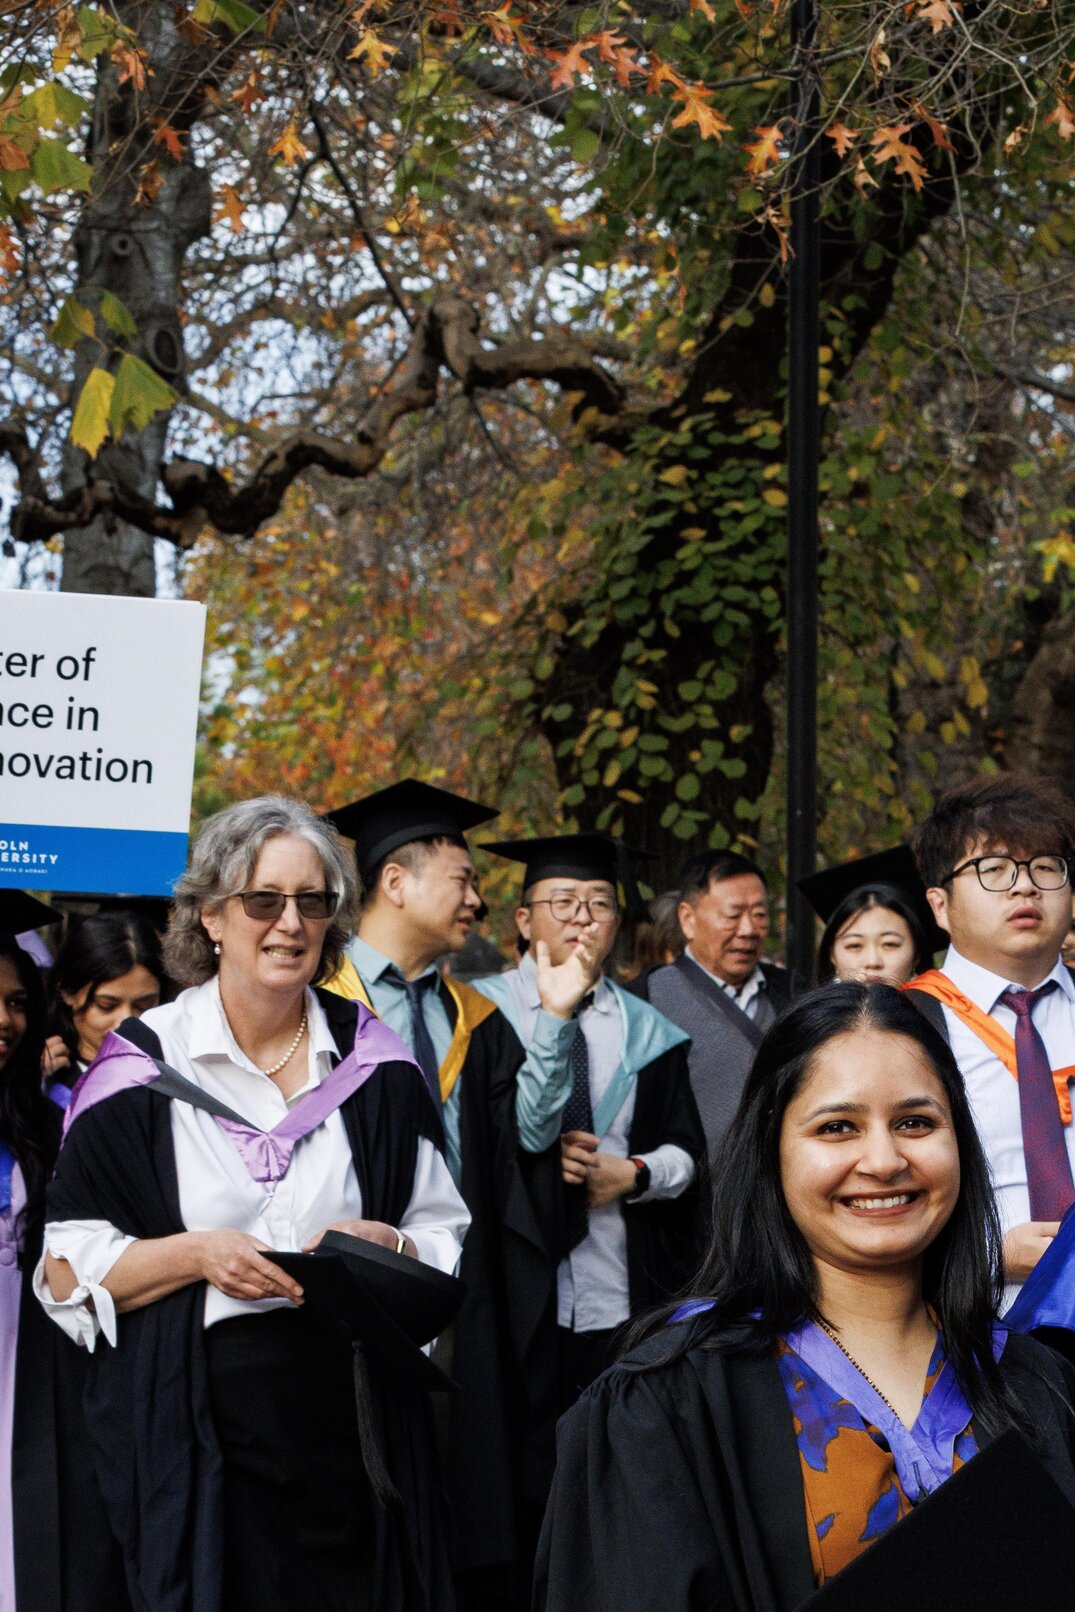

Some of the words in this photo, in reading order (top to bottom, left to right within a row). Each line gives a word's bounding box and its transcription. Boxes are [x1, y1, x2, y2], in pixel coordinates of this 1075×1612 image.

[0, 652, 45, 678] er
[56, 647, 97, 681] of
[0, 701, 54, 729] ce
[66, 696, 100, 731] in
[0, 747, 154, 784] ovation
[0, 840, 29, 851] OLN
[1, 852, 58, 865] ERSITY
